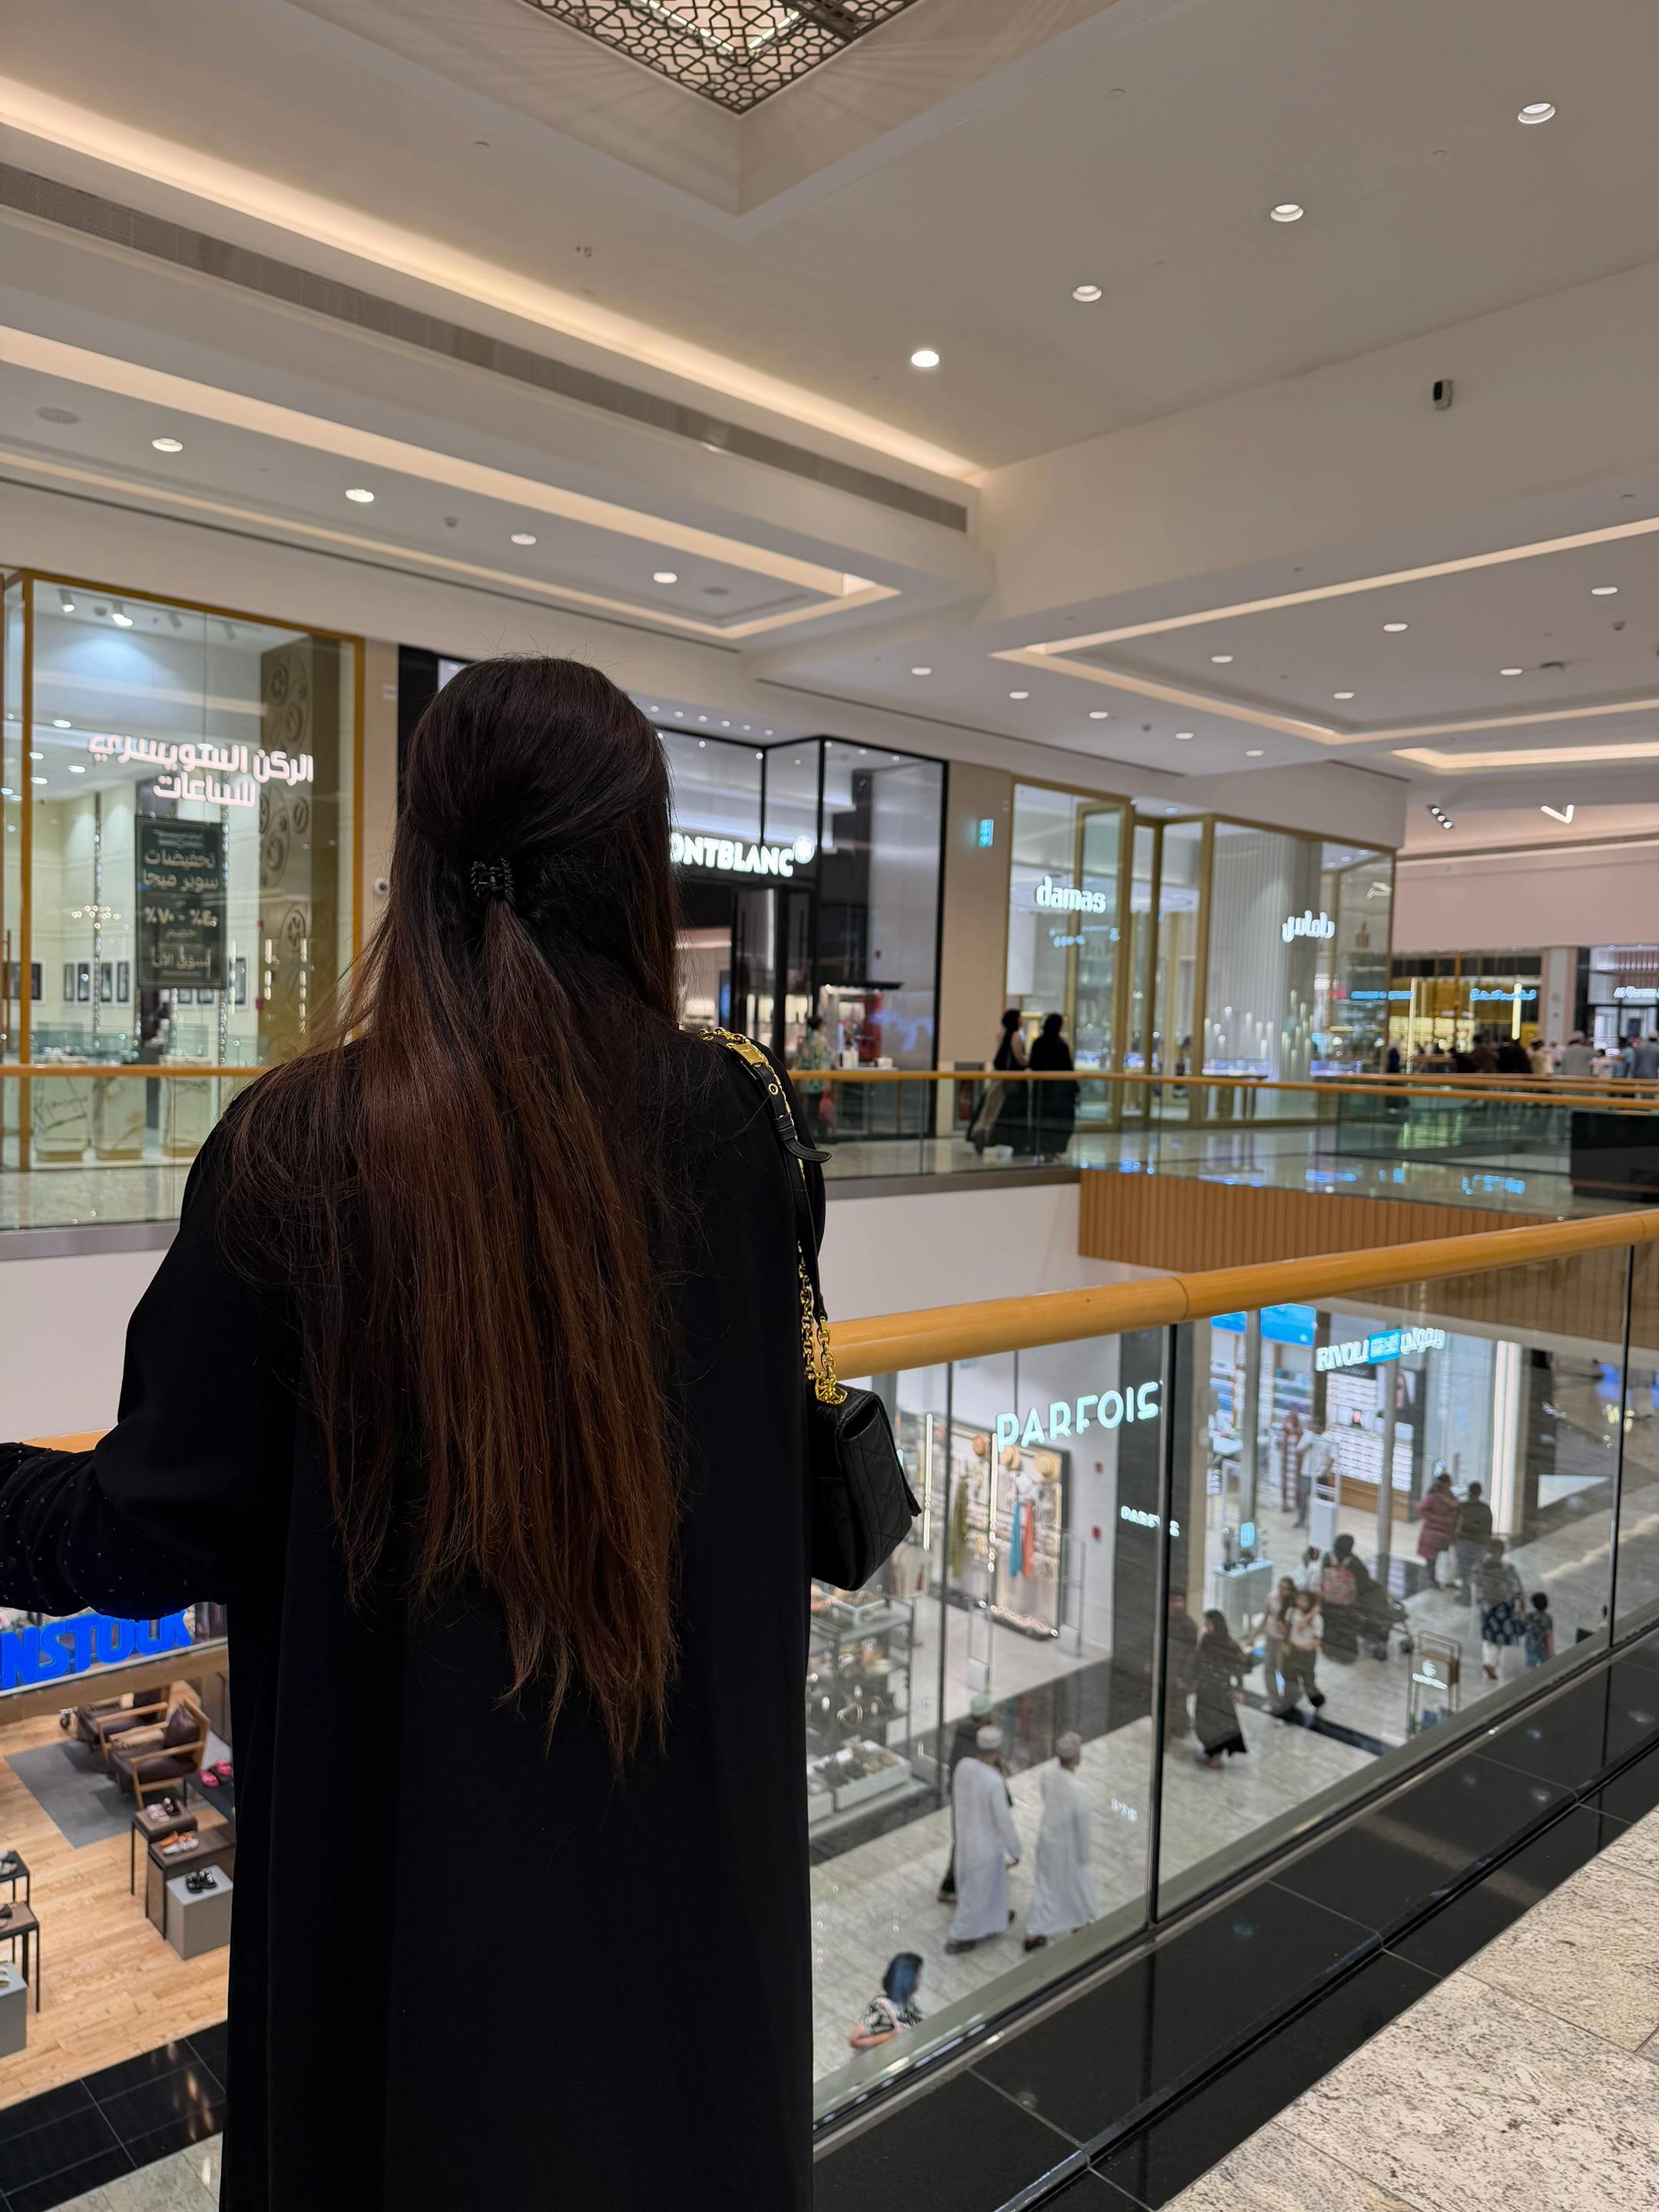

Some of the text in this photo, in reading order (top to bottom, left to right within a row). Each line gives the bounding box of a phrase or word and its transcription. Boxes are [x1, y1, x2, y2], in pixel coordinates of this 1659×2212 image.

[88, 733, 313, 786] الركن السويسري
[153, 771, 256, 806] للساعات
[144, 848, 216, 869] تخفيضات
[671, 832, 794, 877] ONTBLANC
[1036, 875, 1107, 914] damas
[1316, 1339, 1370, 1372] RIVOLI
[995, 1381, 1160, 1454] PARFOIS
[0, 1610, 193, 1690] NSTOCK
